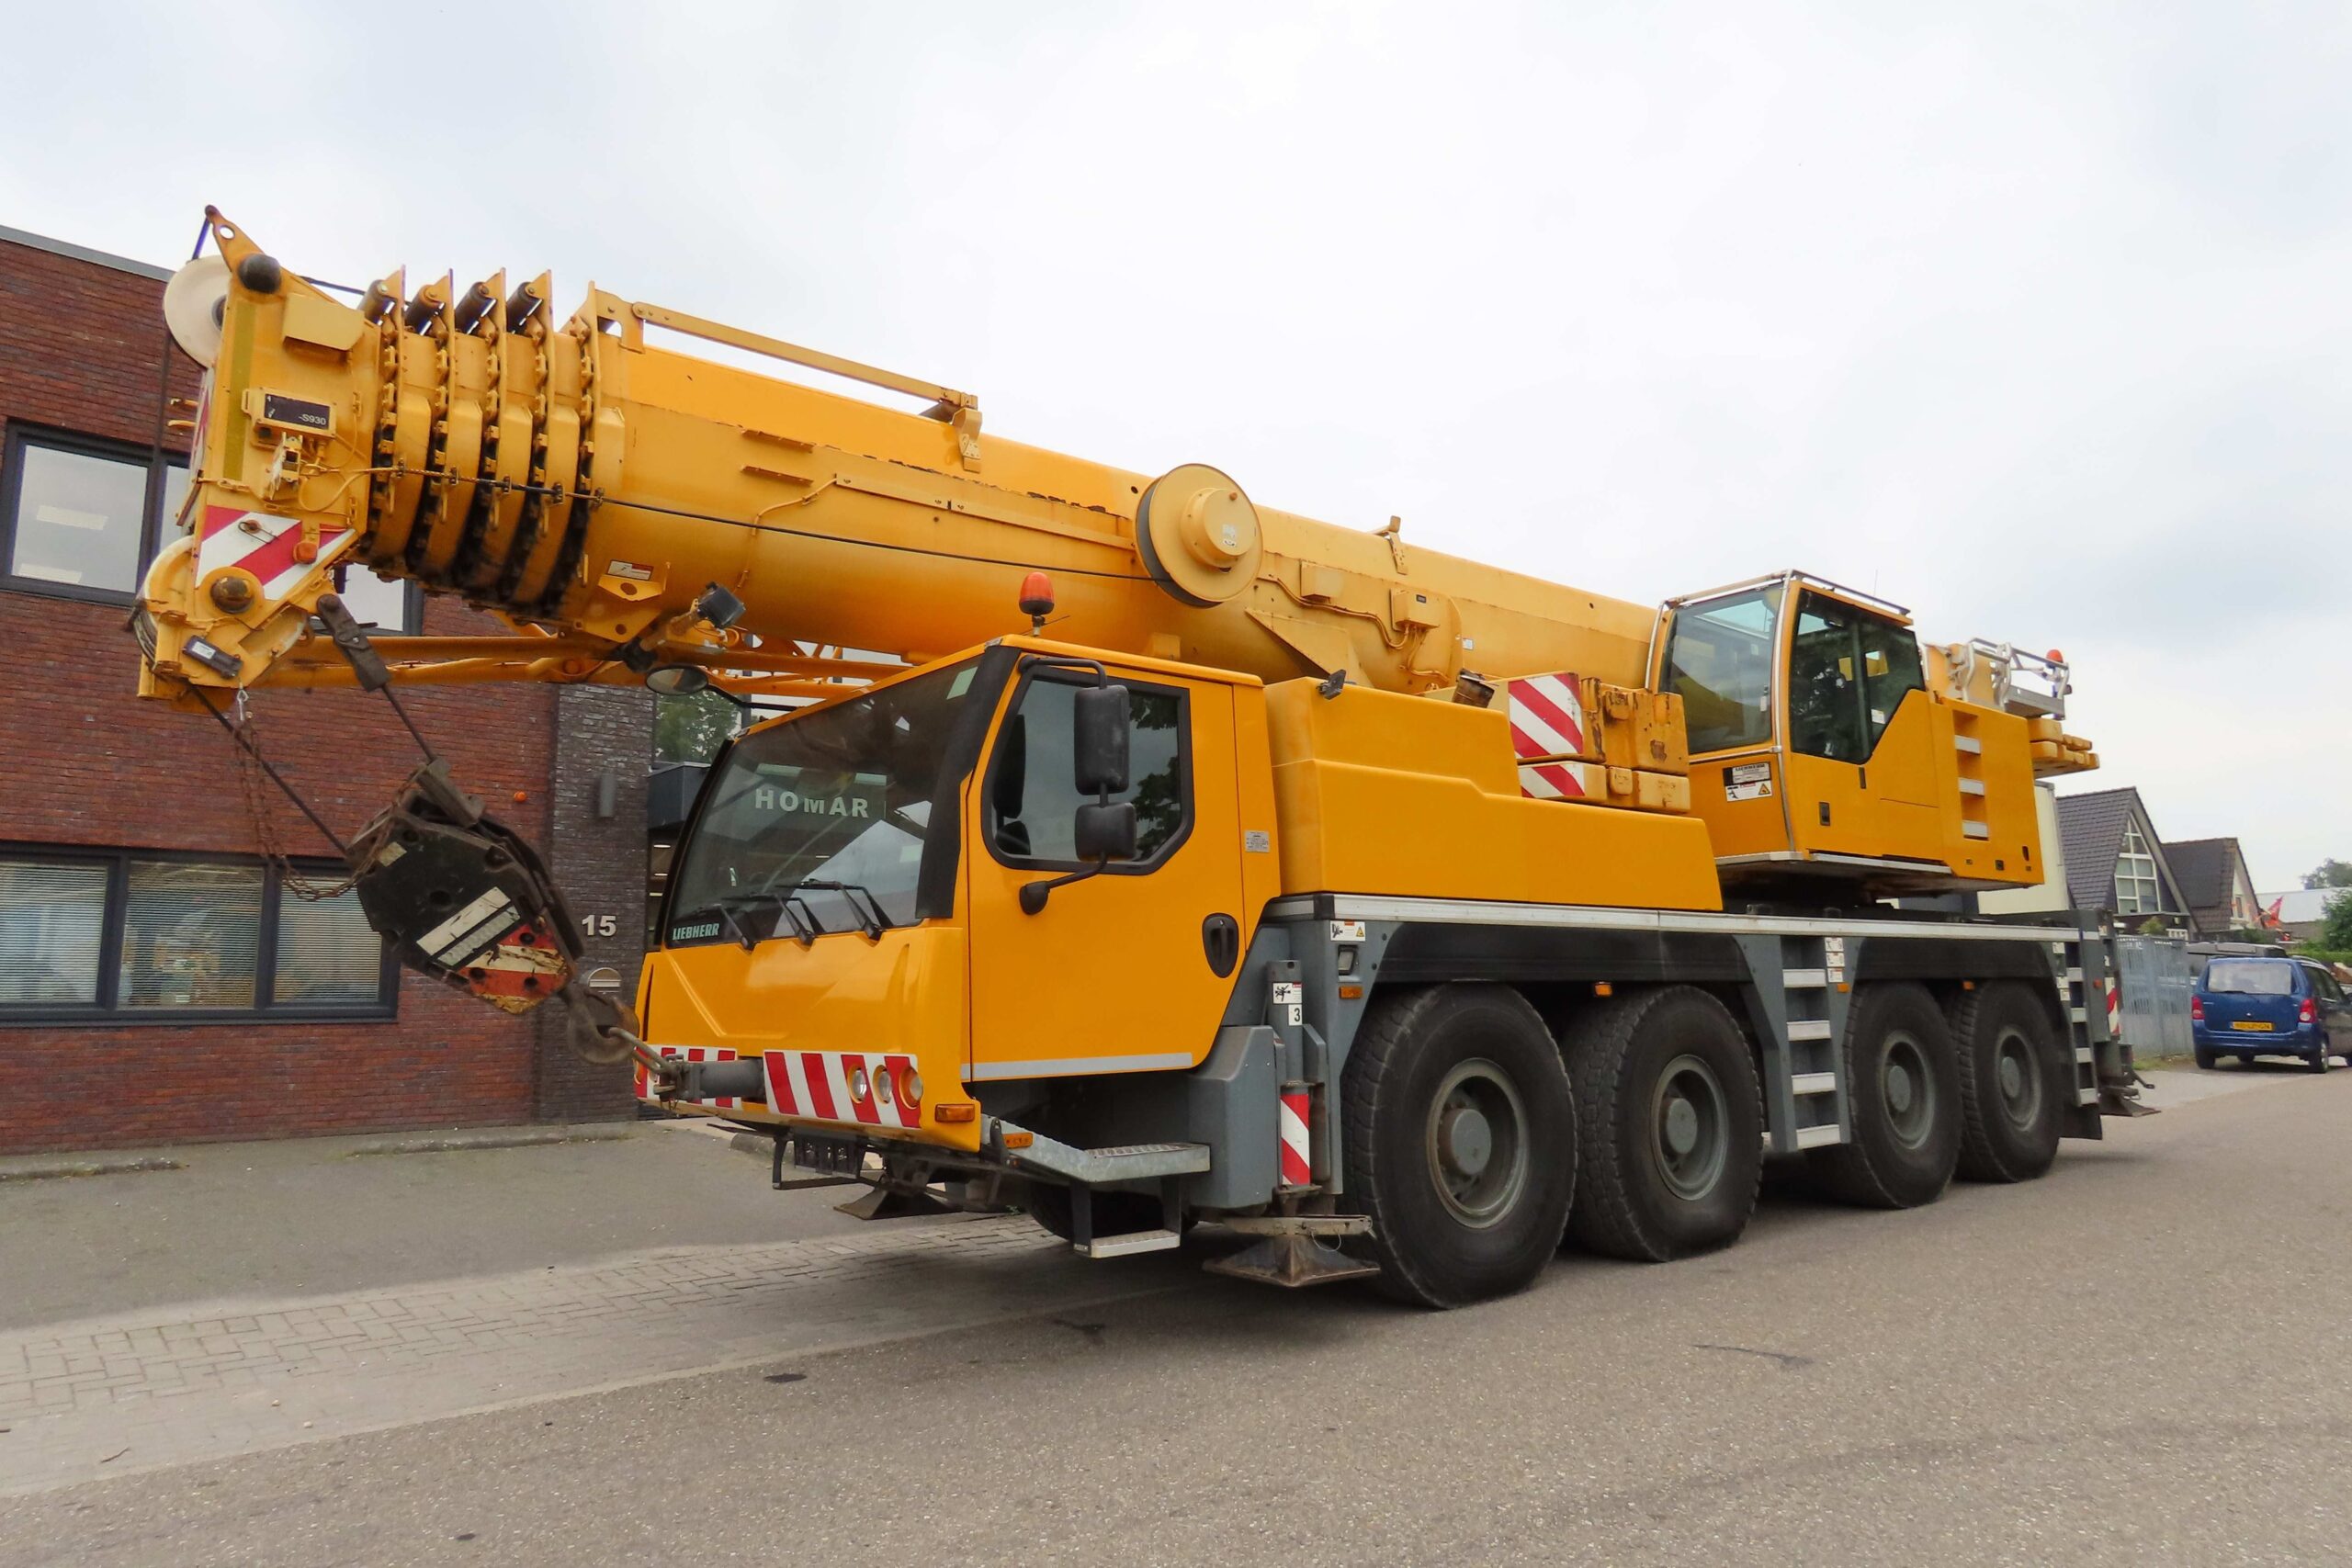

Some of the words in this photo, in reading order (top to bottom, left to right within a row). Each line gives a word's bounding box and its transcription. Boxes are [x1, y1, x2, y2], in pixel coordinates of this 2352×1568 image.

[582, 914, 616, 937] 15
[672, 922, 720, 941] LIEBHERR
[1294, 1007, 1301, 1022] 3
